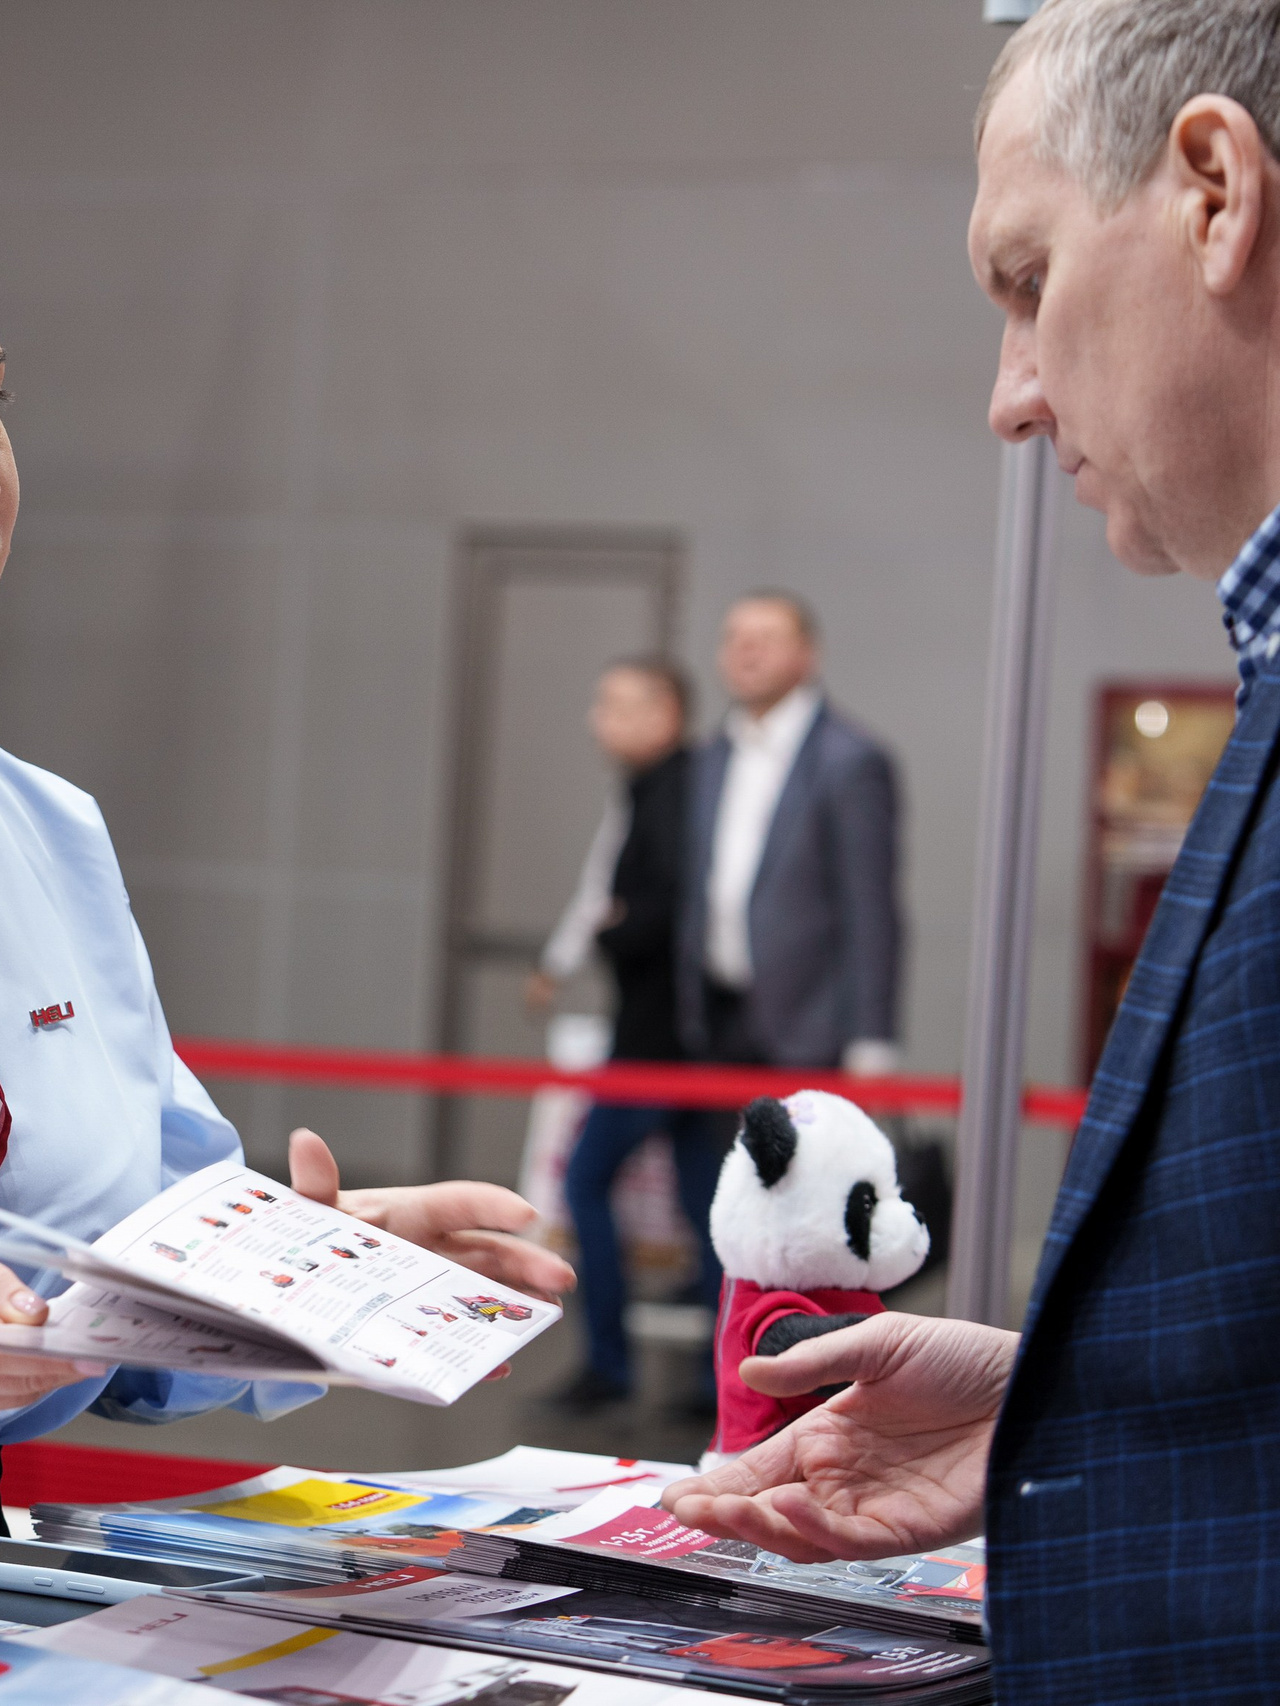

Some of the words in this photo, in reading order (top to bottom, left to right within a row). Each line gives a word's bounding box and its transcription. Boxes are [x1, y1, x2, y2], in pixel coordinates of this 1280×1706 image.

[29, 1000, 75, 1027] HELI
[356, 1573, 415, 1589] HELI
[125, 1612, 189, 1635] HELI
